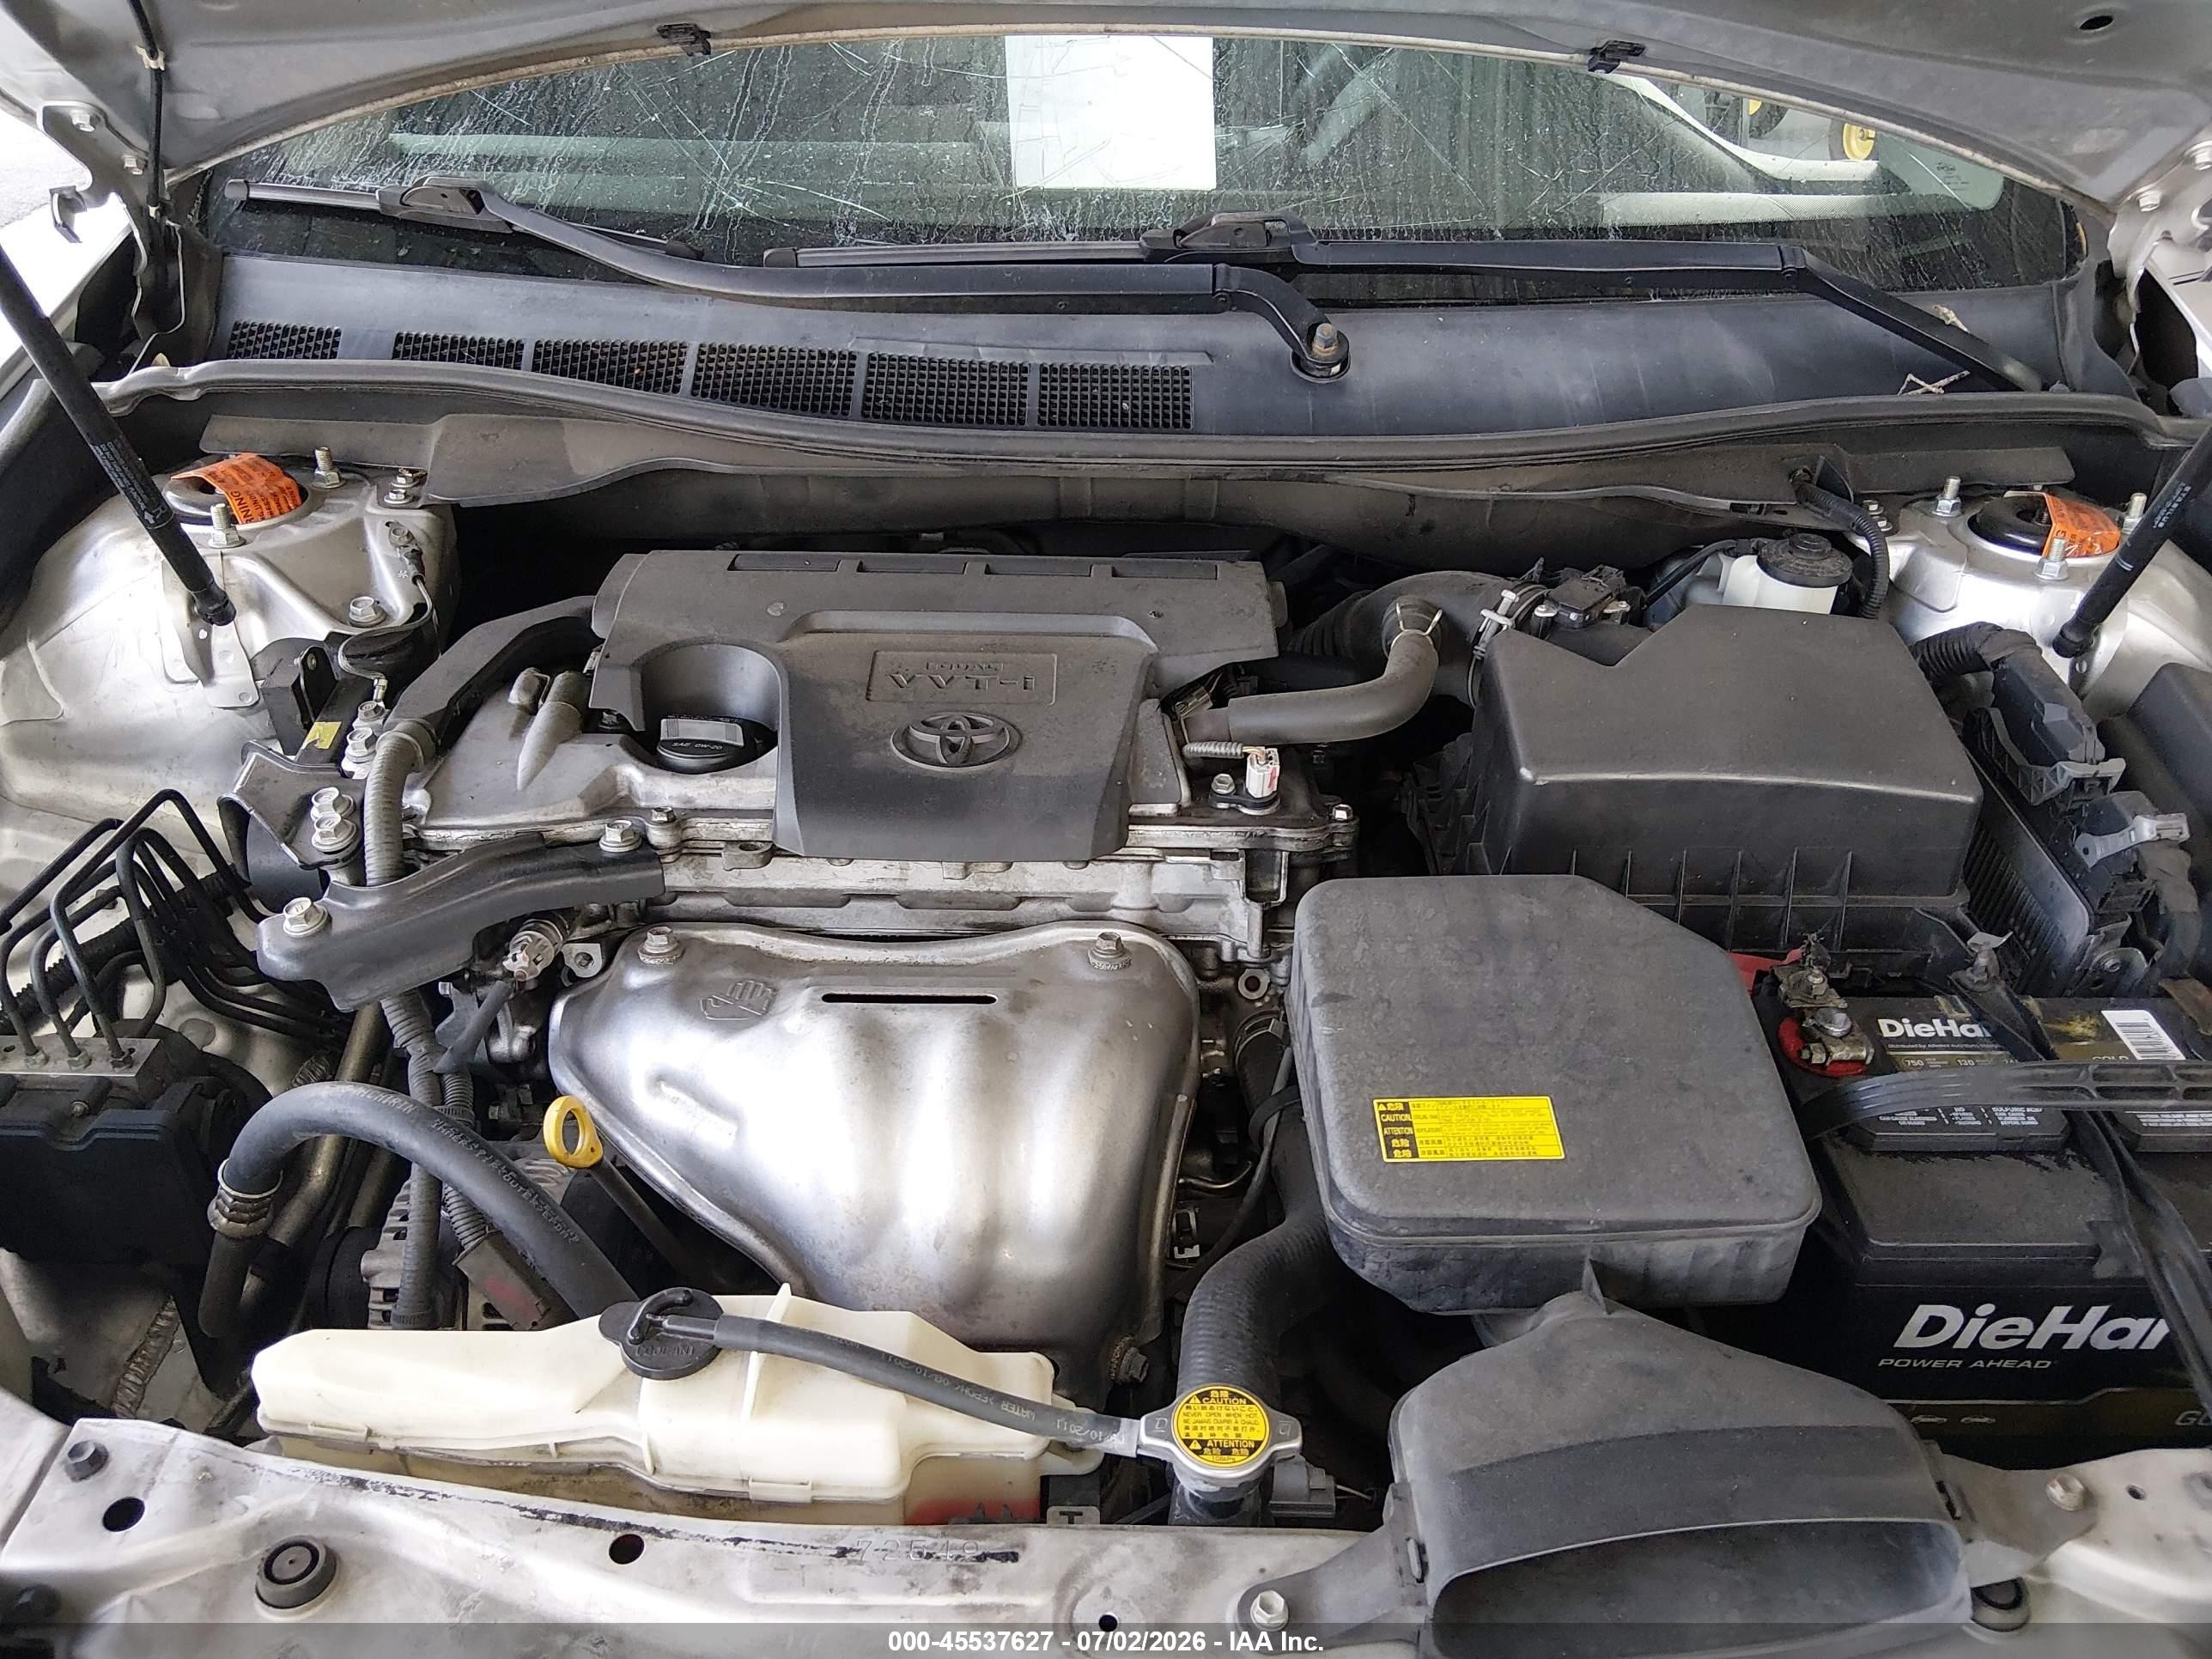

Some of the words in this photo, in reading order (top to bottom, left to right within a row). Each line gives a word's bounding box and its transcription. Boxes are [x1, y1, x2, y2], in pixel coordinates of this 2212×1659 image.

[1877, 1018, 1991, 1038] DieHar
[1384, 1127, 1413, 1135] ATTENTION
[1893, 1303, 2170, 1350] DieHar
[1877, 1358, 1963, 1368] POWER
[1969, 1359, 2052, 1370] AHEAD
[1000, 1400, 1036, 1421] WATER
[1206, 1440, 1255, 1449] ATTENTION
